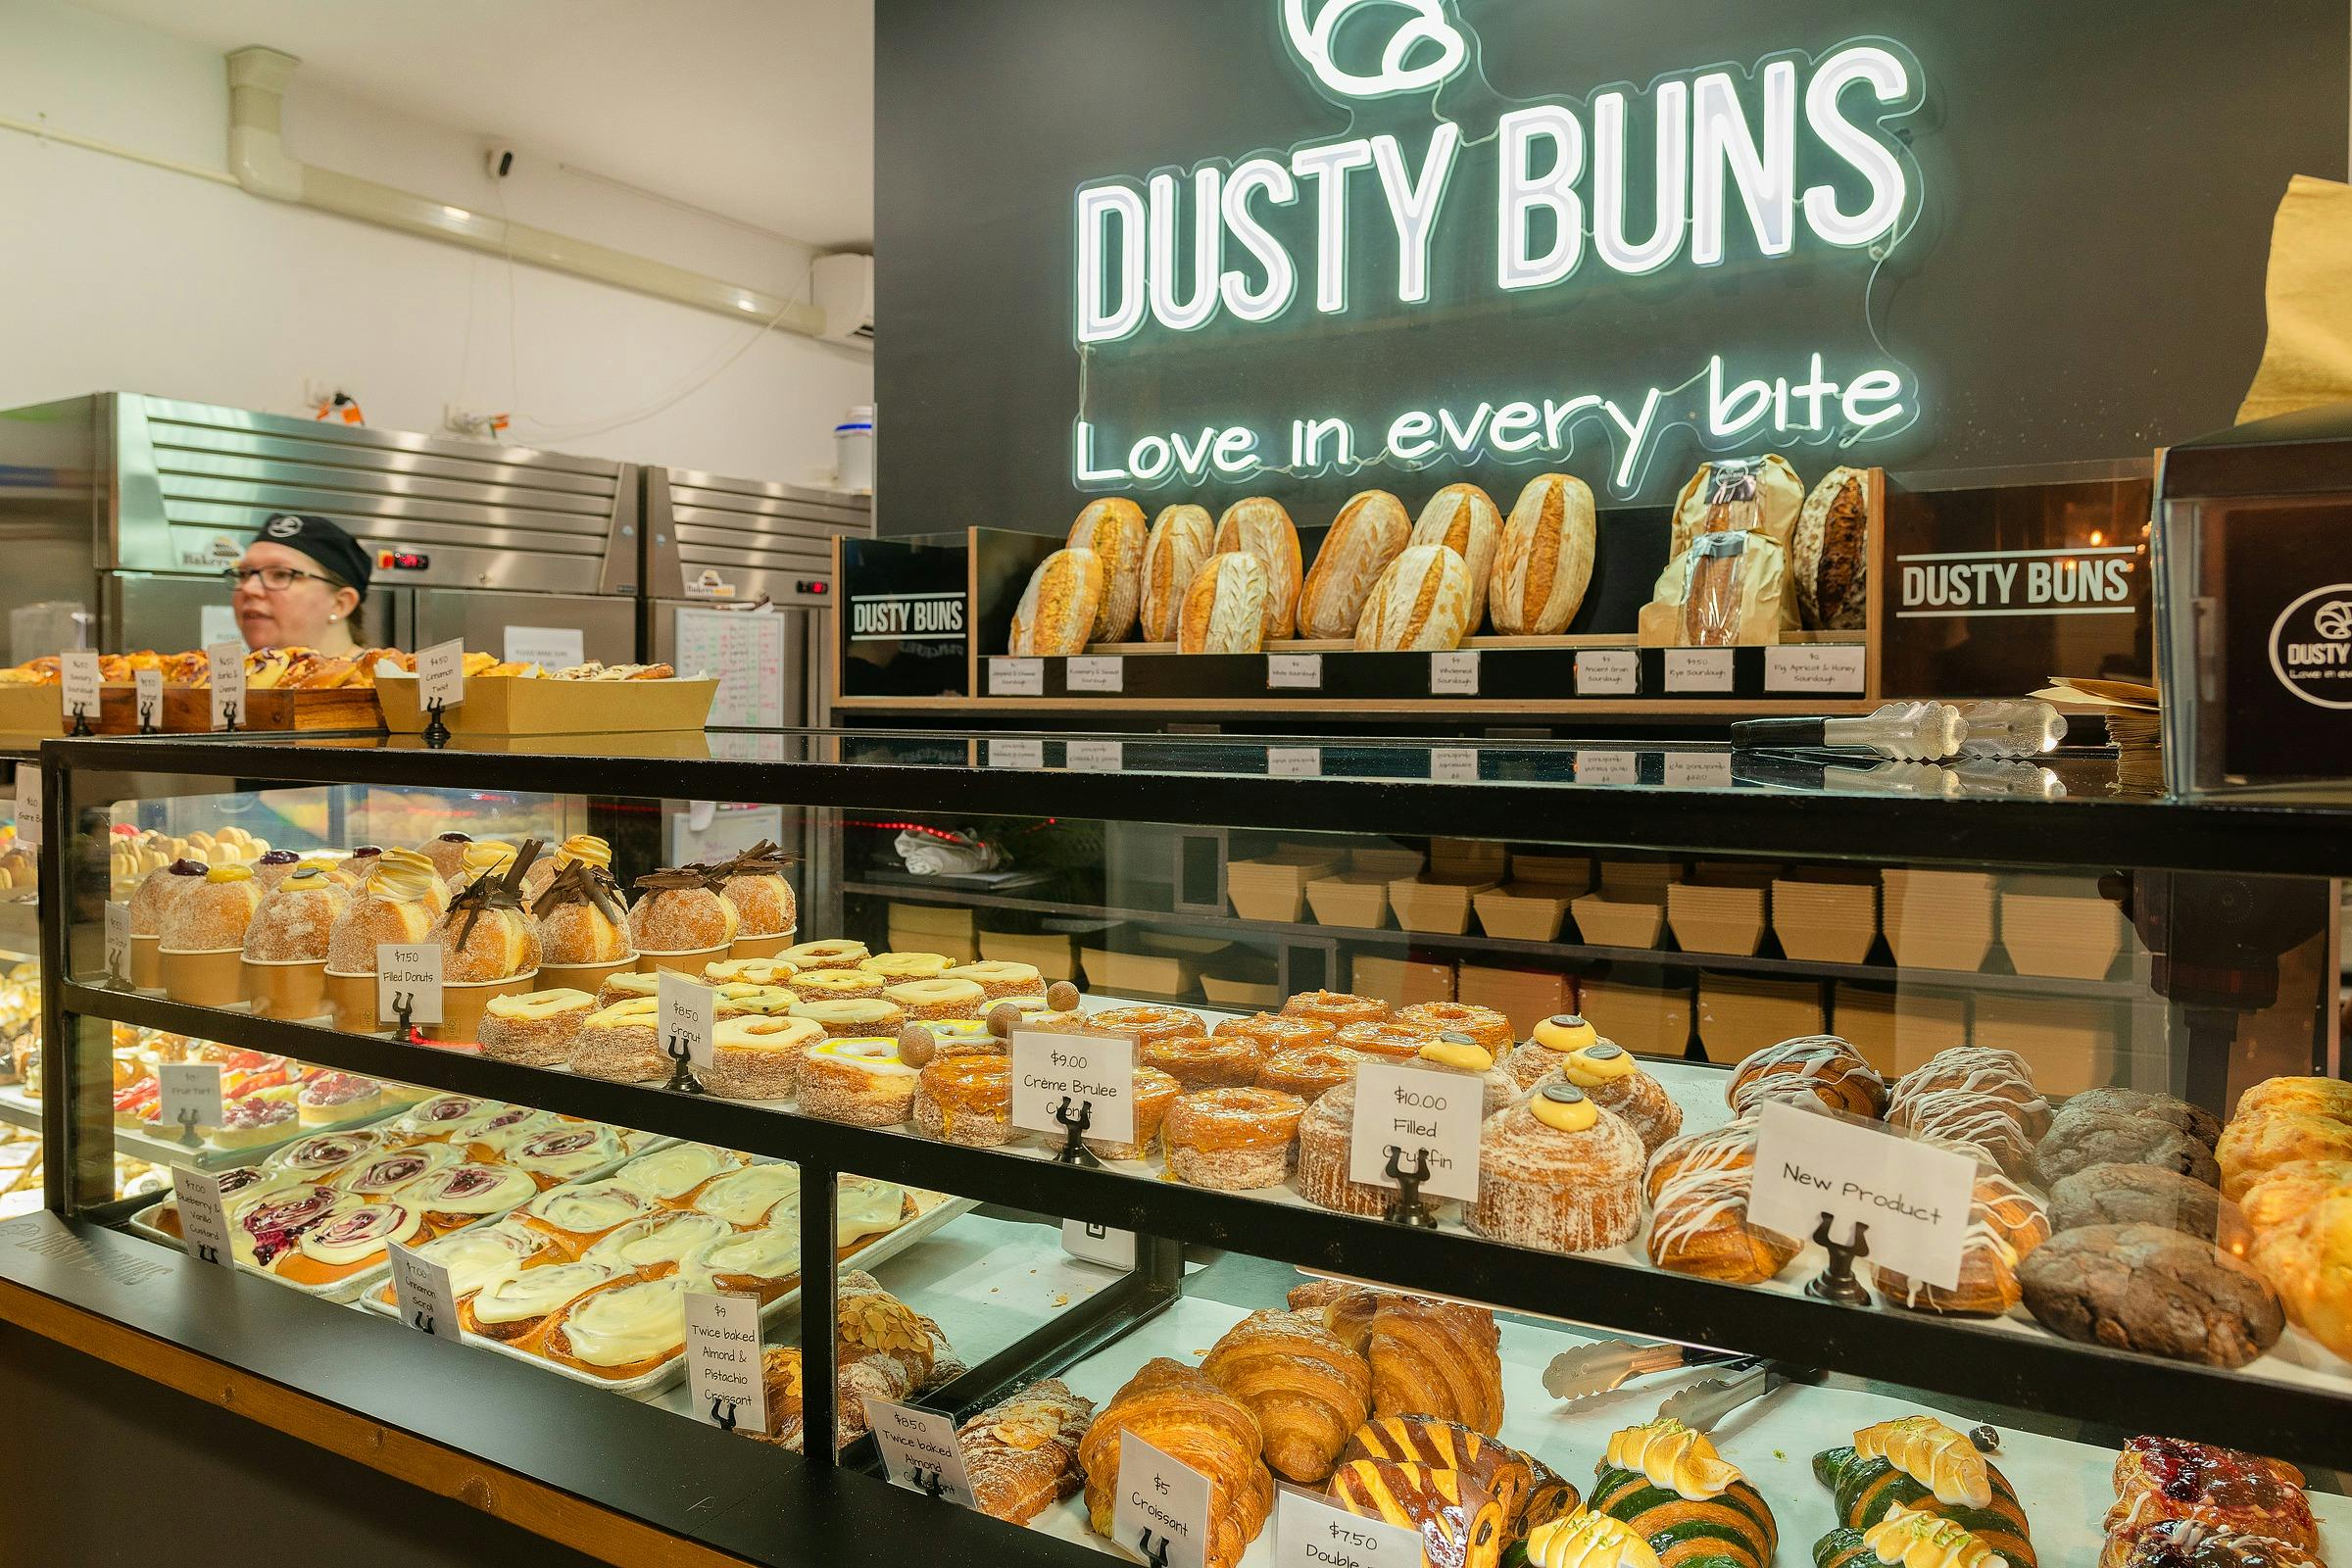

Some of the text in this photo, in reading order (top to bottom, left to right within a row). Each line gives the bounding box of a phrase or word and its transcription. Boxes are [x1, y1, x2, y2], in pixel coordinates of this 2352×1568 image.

[1078, 46, 1909, 343] DUSTY BUNS
[1077, 355, 1902, 488] Love in every bite
[1902, 559, 2129, 607] DUSTY BUNS
[855, 600, 963, 632] DUSTY BUNS
[2288, 643, 2351, 664] DUSTY
[1687, 669, 1726, 679] Sourdough
[1790, 663, 1820, 673] Apricot
[1832, 664, 1856, 674] Honey
[1793, 675, 1837, 686] Sourdough
[383, 969, 433, 983] Filled Donuts
[673, 1000, 698, 1022] $8.50
[670, 1022, 701, 1044] Cronut
[1051, 1049, 1088, 1069] $9.00
[1023, 1074, 1117, 1098] Crème Brulee
[1394, 1085, 1447, 1111] $10.00
[1394, 1117, 1438, 1138] Filled
[176, 1191, 212, 1214] Blueberry
[1783, 1162, 1942, 1225] New Product
[190, 1210, 212, 1224] Vanilla
[189, 1224, 220, 1241] Custard
[405, 1276, 437, 1299] Cinnamon
[714, 1302, 727, 1318] $9
[692, 1324, 756, 1343] Twice baked
[703, 1346, 748, 1363] Almond &
[705, 1368, 748, 1385] Pistachio
[705, 1389, 753, 1407] Croissant
[894, 1411, 927, 1433] $8.50
[882, 1429, 954, 1459] Twice baked
[905, 1452, 943, 1473] Almond
[1153, 1473, 1171, 1495] $5
[1131, 1492, 1189, 1538] Croissant
[1329, 1520, 1378, 1550] $7.50
[1306, 1544, 1359, 1568] Double
